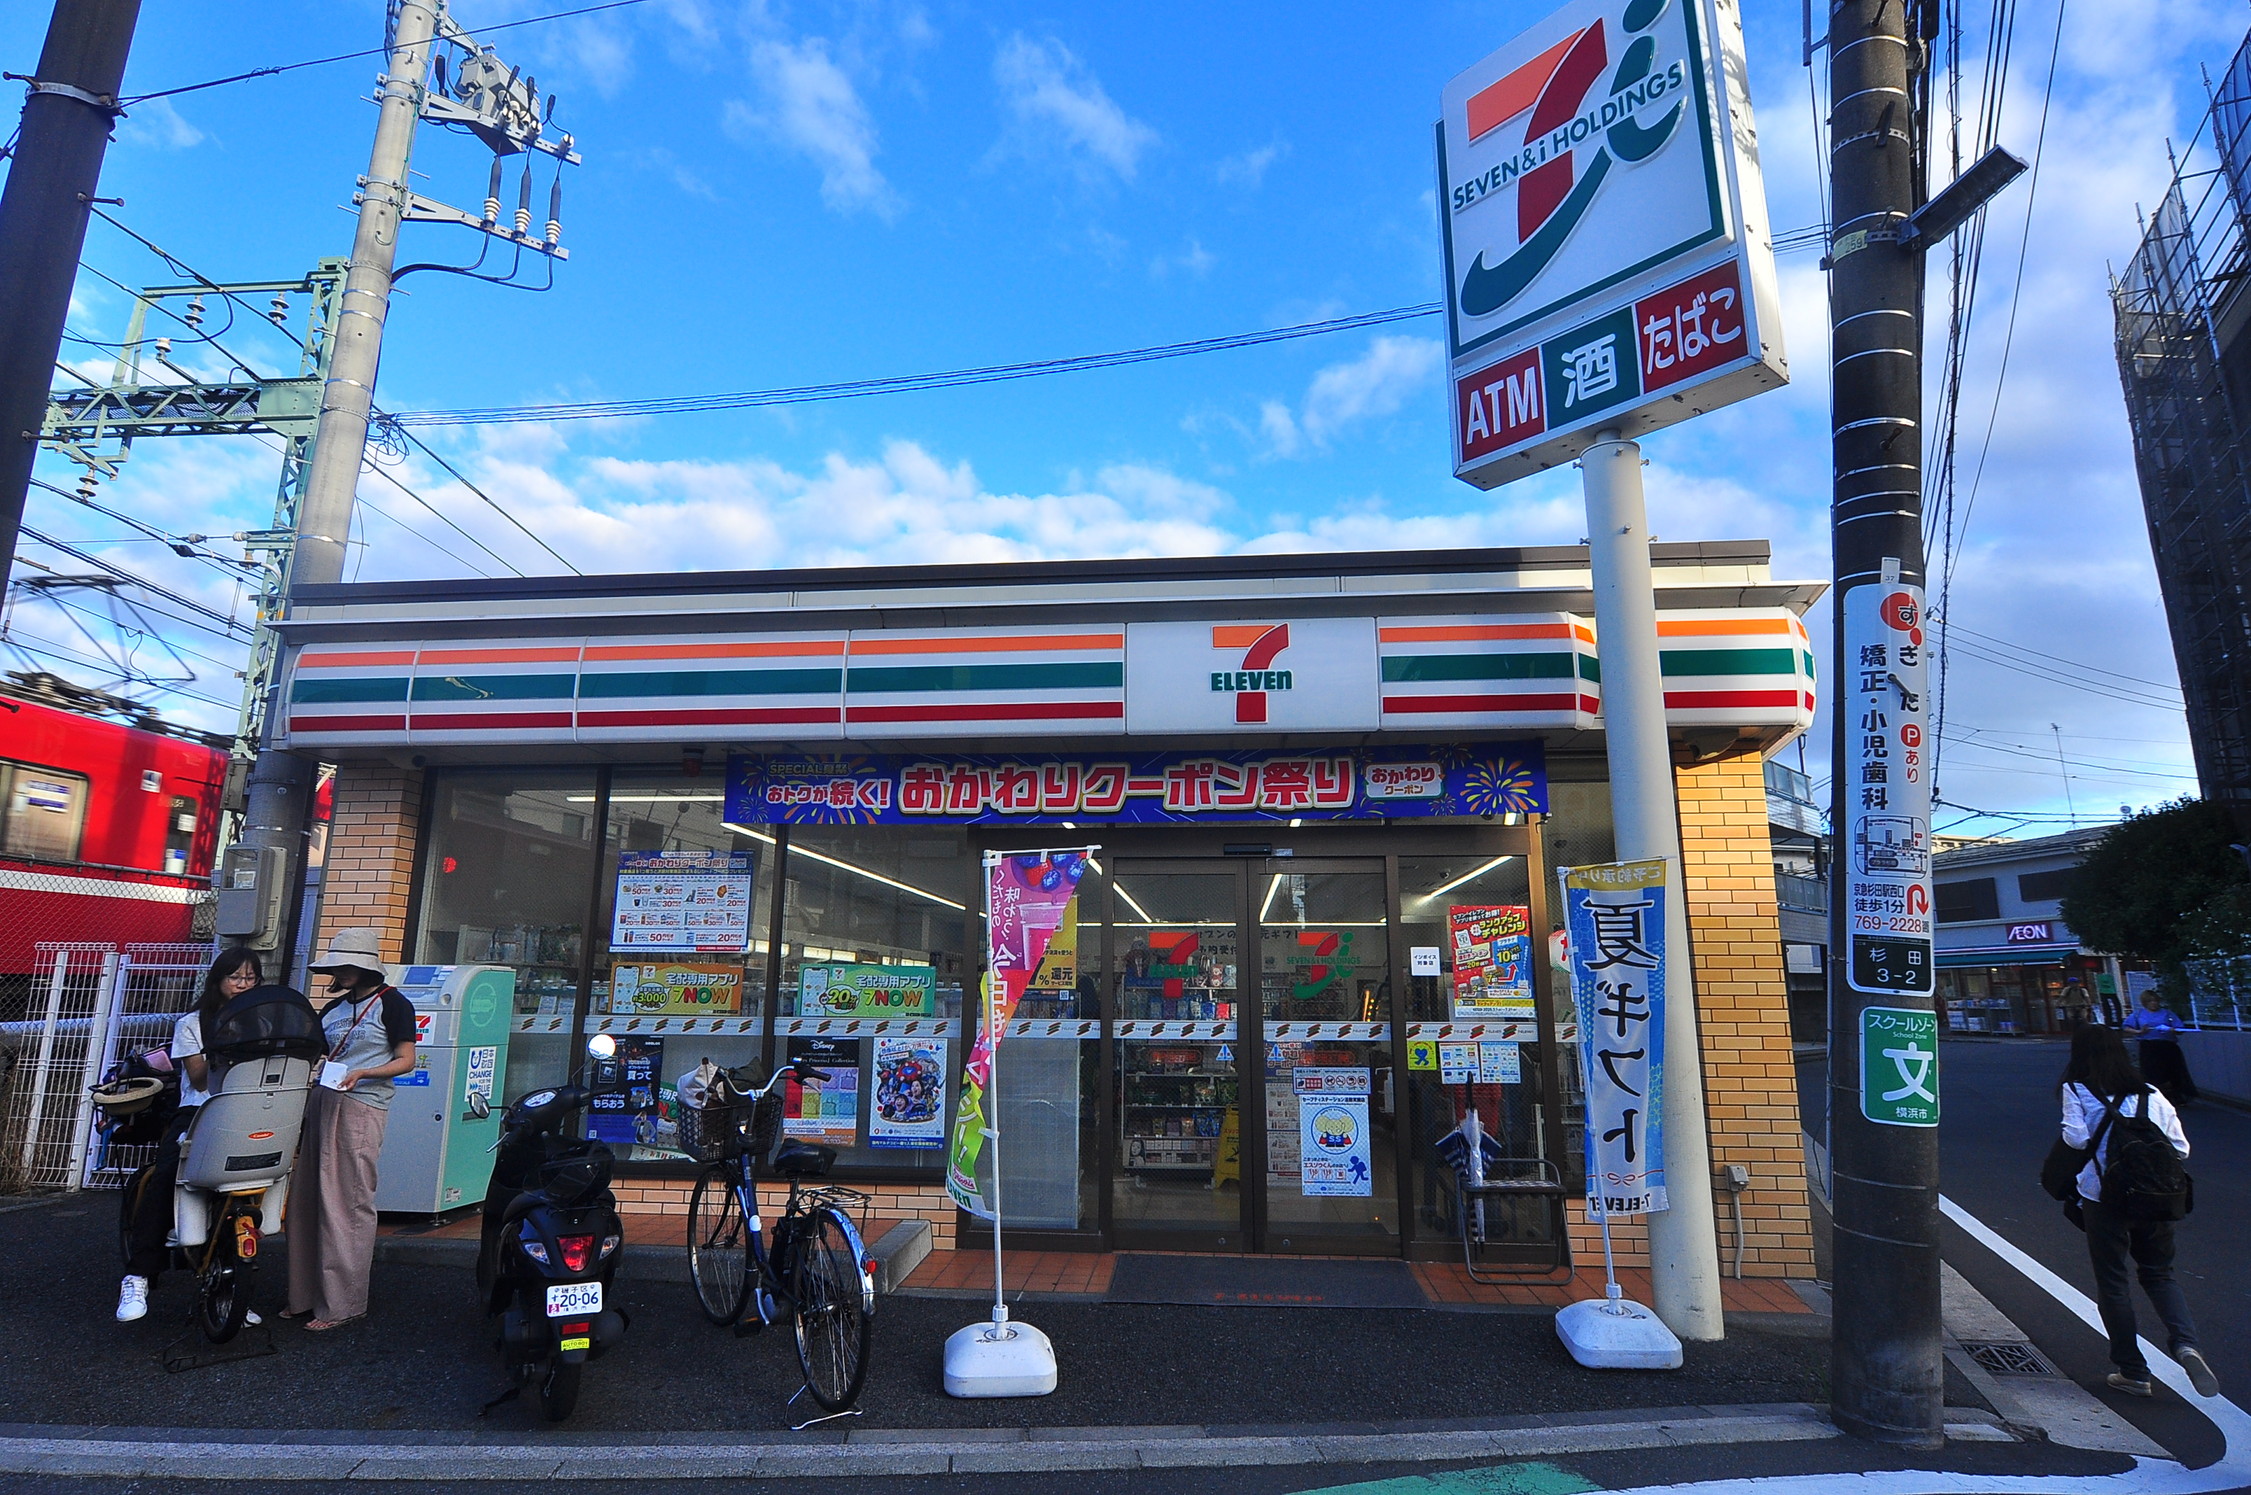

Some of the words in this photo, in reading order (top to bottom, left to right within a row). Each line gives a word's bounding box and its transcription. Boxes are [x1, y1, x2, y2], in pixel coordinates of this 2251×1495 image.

[1454, 155, 1518, 210] SEVEN
[1522, 146, 1537, 171] &
[1539, 142, 1547, 162] i
[1554, 63, 1682, 154] HOLDINGS
[1644, 287, 1741, 373] たばこ
[1562, 333, 1616, 408] 酒
[1466, 366, 1538, 445] ATM
[1860, 644, 1888, 811] 矯正・小児歯科
[1370, 767, 1436, 784] おかわり
[766, 778, 891, 808] おトクが続く!
[901, 756, 1356, 814] おかわりクーポン祭り
[1384, 784, 1423, 794] クーポン
[1854, 883, 1904, 897] 京急杉田駅西口
[1855, 899, 1905, 913] 徒歩1分
[1854, 916, 1922, 932] 769-2228
[1051, 967, 1072, 980] 還元
[1877, 968, 1916, 984] 3-2
[673, 987, 729, 1004] 7NOW
[863, 990, 922, 1007] 7NOW
[810, 1040, 835, 1051] Disney
[469, 1070, 492, 1079] CHANGE
[627, 1071, 652, 1080] 買って
[1882, 1042, 1935, 1103] 文
[478, 1084, 490, 1092] BLUE
[593, 1099, 625, 1108] もらおう
[1896, 1107, 1927, 1119] 横浜市
[560, 1292, 598, 1307] 20-06
